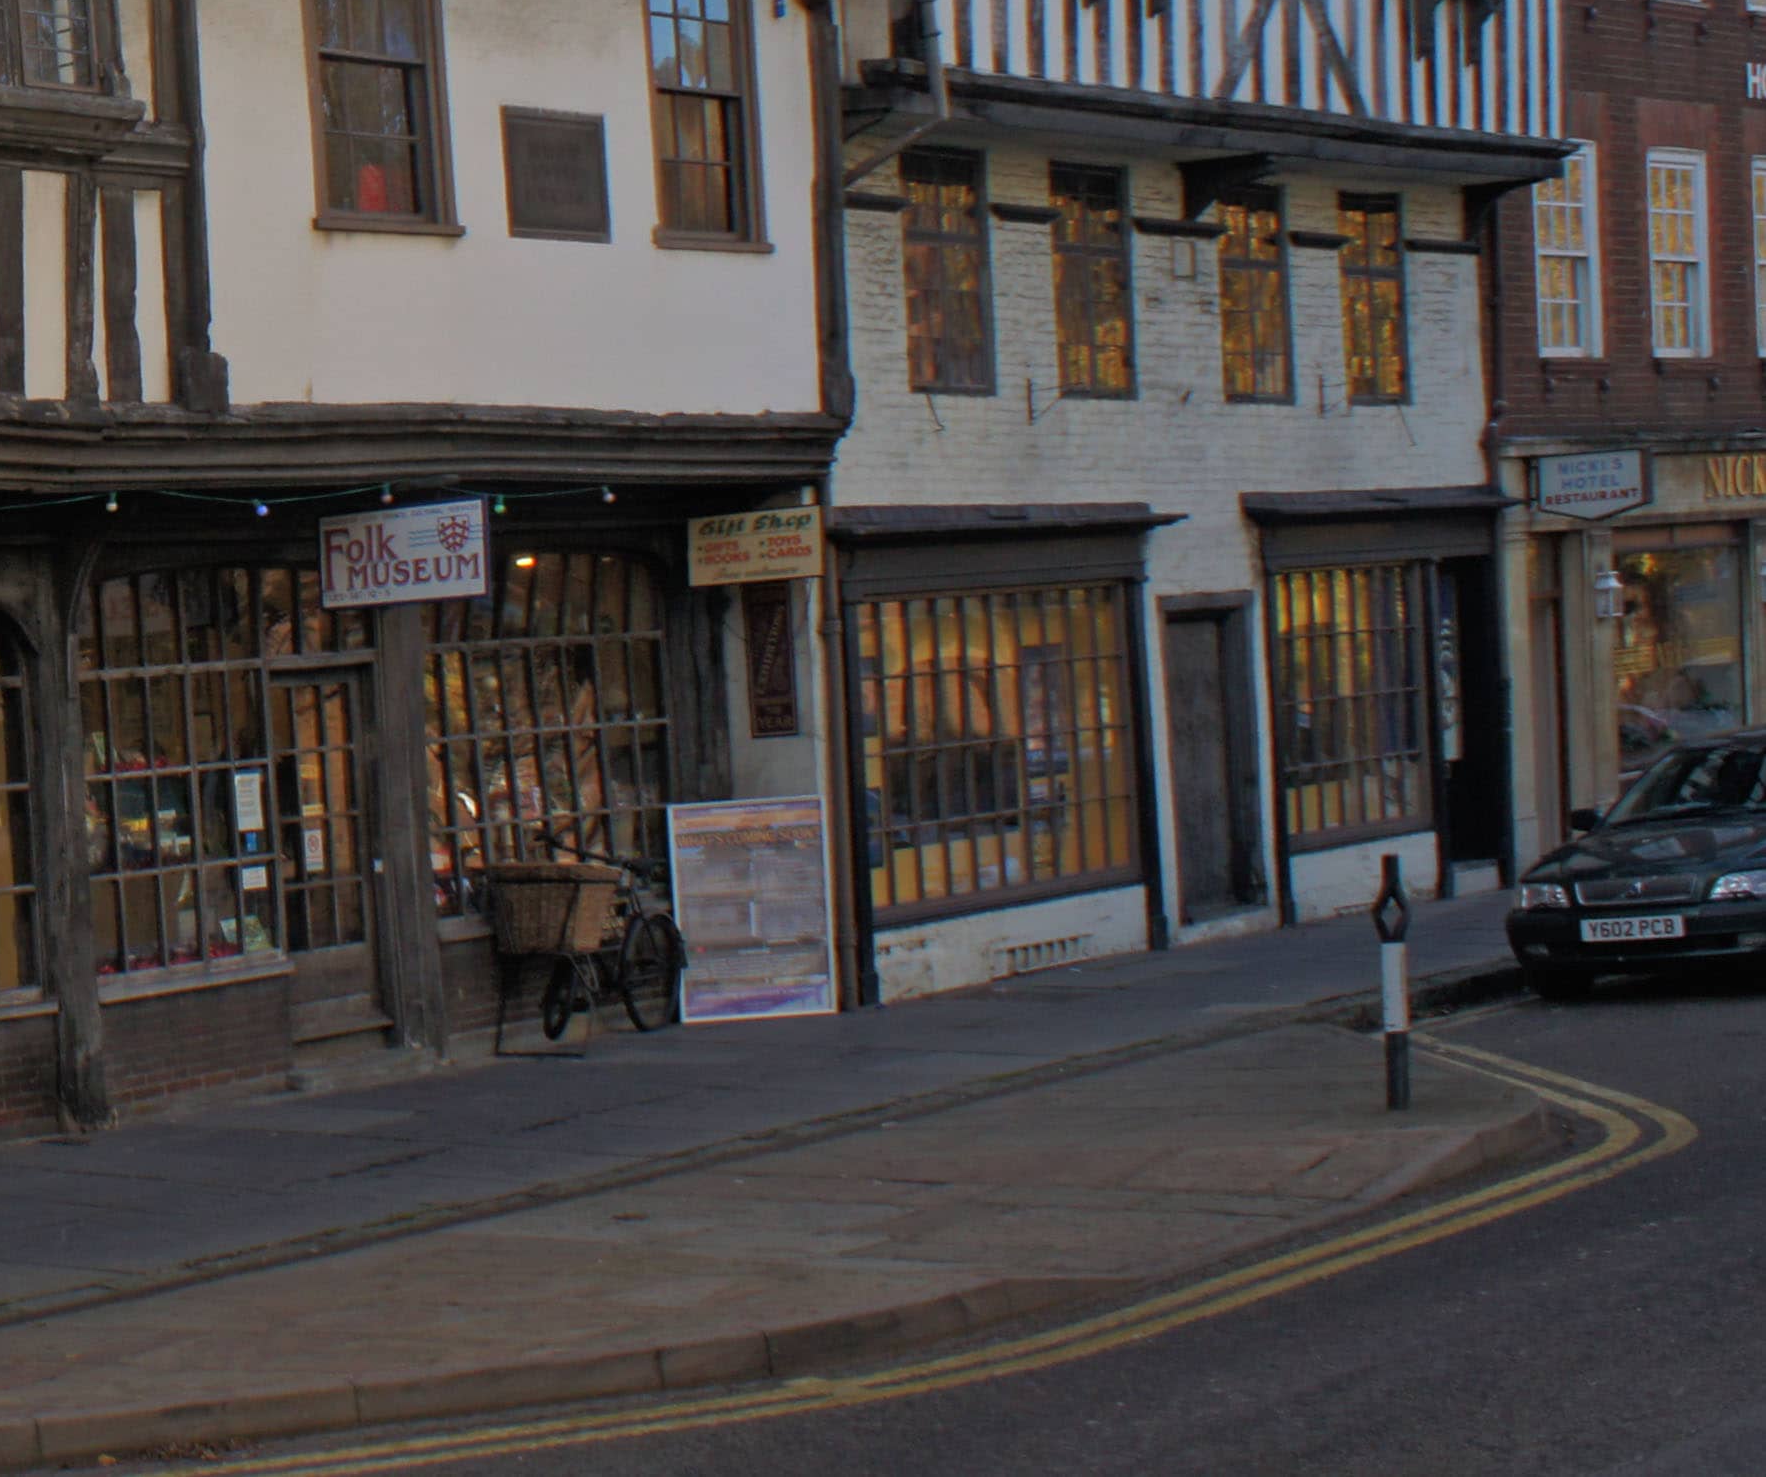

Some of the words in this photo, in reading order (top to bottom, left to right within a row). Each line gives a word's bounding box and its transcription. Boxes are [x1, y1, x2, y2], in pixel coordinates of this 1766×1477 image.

[1745, 61, 1766, 99] H
[1561, 474, 1620, 490] HOTEL
[1545, 488, 1639, 505] RESTAURANT
[752, 512, 812, 531] Shop
[766, 534, 802, 547] TOYS
[323, 523, 398, 591] Folk
[767, 545, 813, 559] CARDS
[346, 552, 482, 591] MUSEUM
[1588, 920, 1634, 938] Y602
[1638, 918, 1675, 935] PCB
